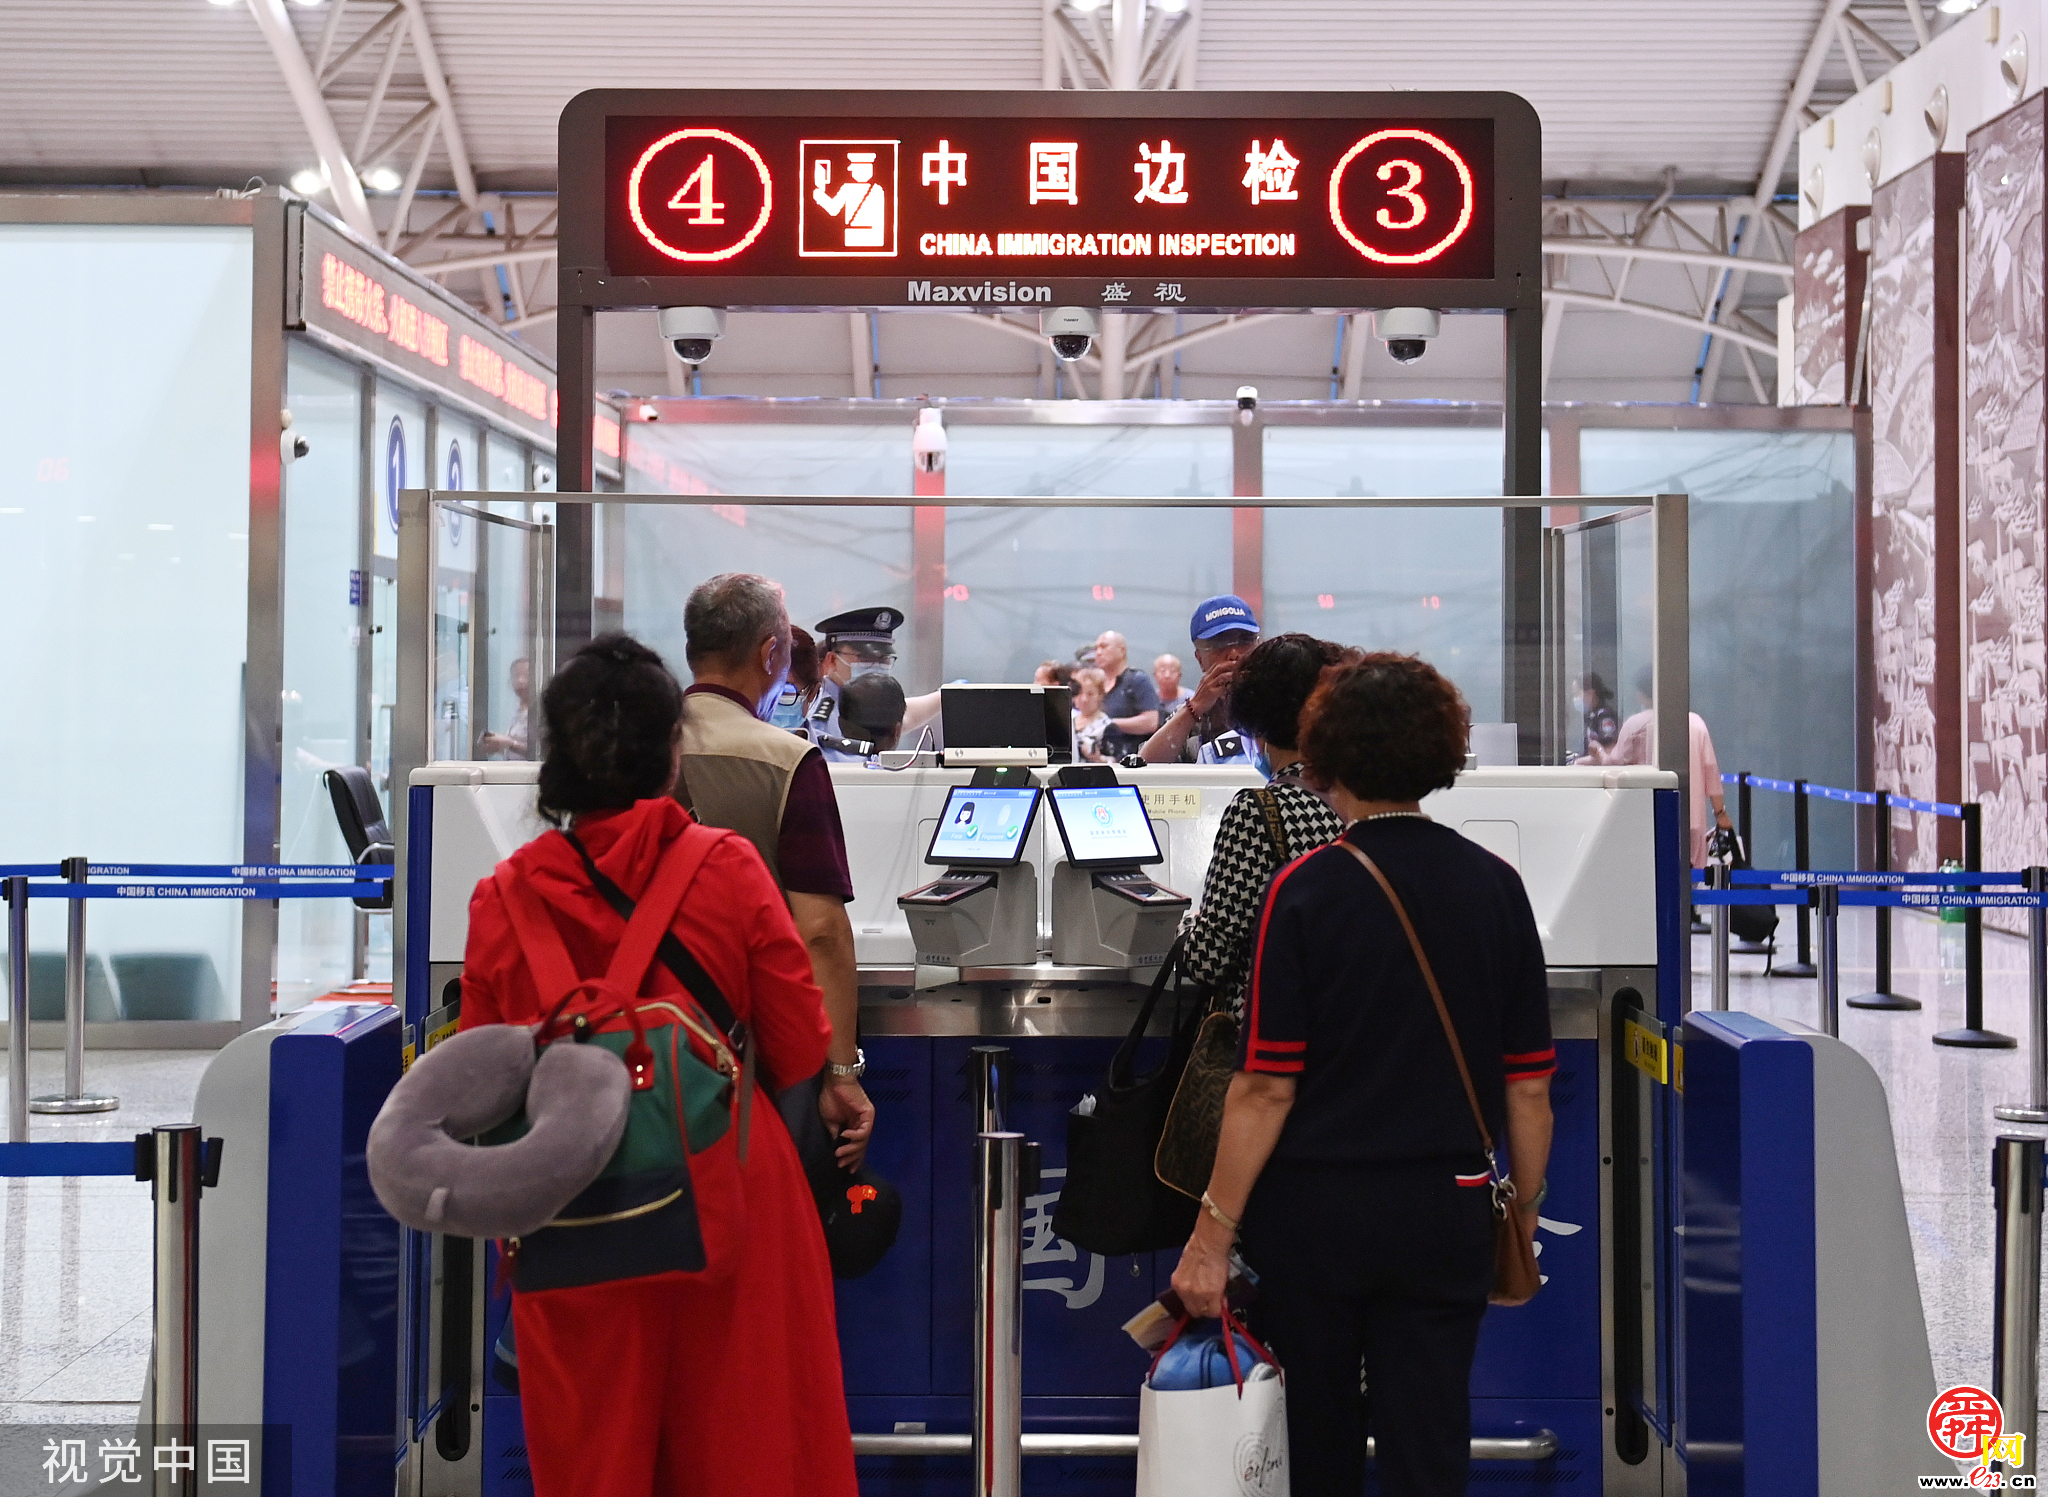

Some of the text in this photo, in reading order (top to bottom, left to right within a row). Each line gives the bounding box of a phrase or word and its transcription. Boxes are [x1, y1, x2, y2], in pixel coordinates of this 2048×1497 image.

[921, 139, 1300, 205] 中国边检
[667, 154, 725, 225] 4
[1376, 159, 1427, 229] 3
[919, 233, 1296, 256] CHINA IMMIGRATION INSPECTION
[907, 280, 1052, 302] Maxvision
[1100, 282, 1187, 302] 盛视
[1205, 606, 1246, 622] MONGOLIA
[231, 866, 356, 877] 中国移民 CHINA IMMIGRATION
[1780, 872, 1905, 884] 中国移民 CHINA IMMIGRATION
[116, 885, 256, 897] 中国移民 CHINA IMMIGRATION
[1901, 893, 2041, 905] 中国移民 CHINA IMMIGRATION
